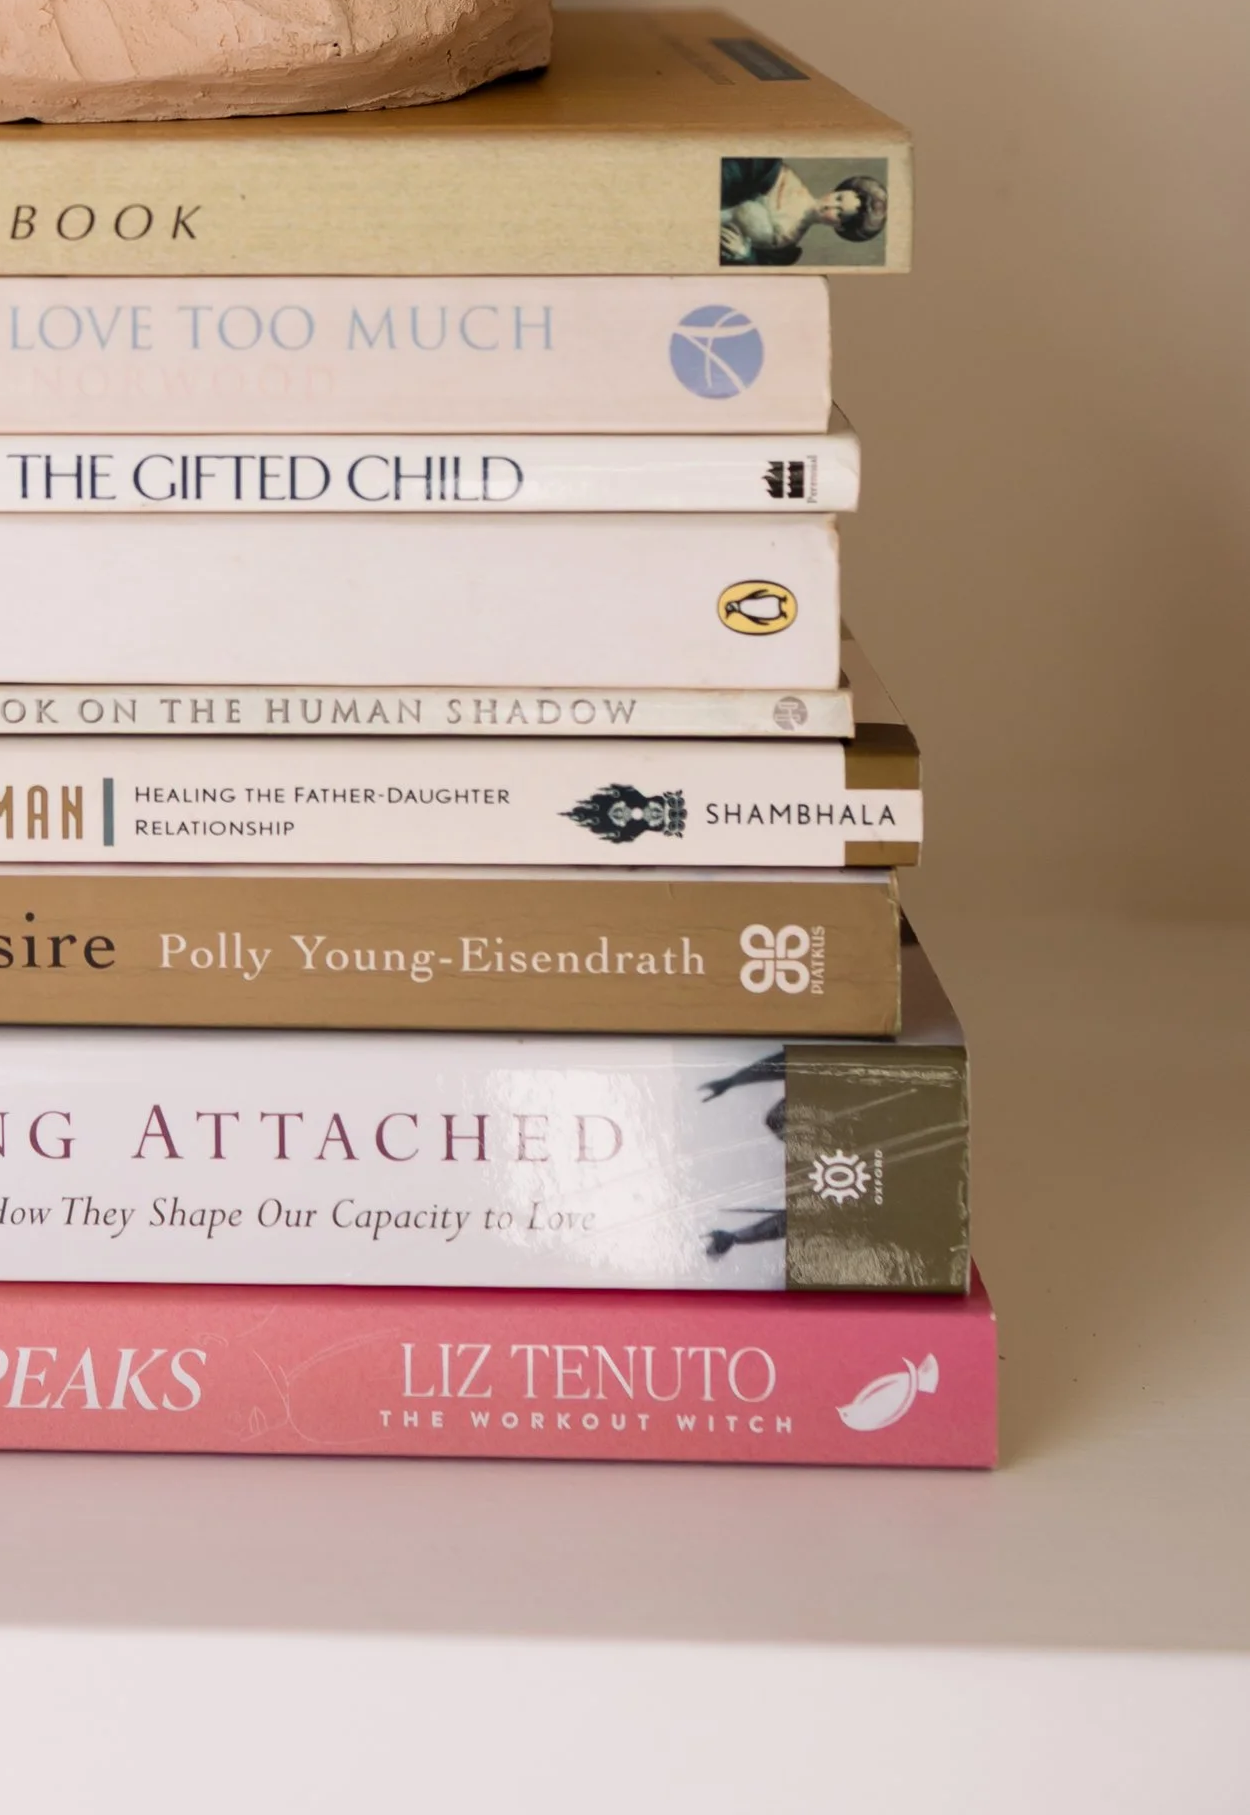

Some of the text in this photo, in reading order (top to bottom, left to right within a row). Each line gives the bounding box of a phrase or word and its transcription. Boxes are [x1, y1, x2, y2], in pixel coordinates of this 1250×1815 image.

[10, 204, 201, 241] BOOK
[11, 303, 153, 351] LOVE
[177, 304, 315, 351] TOO
[348, 304, 554, 351] MUCH
[7, 454, 116, 500] THE
[132, 454, 331, 501] GIFTED
[347, 455, 524, 502] CHILD
[78, 698, 137, 724] ON
[159, 698, 241, 724] THE
[265, 698, 422, 725] HUMAN
[446, 698, 637, 725] SHADOW
[135, 786, 510, 805] HEALING THE FATHER-DAUGHTER
[706, 802, 896, 826] SHAMBHALA
[135, 819, 295, 836] RELATIONSHIP
[159, 931, 705, 983] Polly Young-Eisendrath
[810, 925, 826, 995] PIATKUS
[131, 1104, 625, 1162] ATTACHED
[873, 1148, 884, 1206] OXFORD
[61, 1195, 136, 1239] They
[149, 1196, 243, 1240] Shape
[257, 1198, 318, 1228] Our
[331, 1199, 471, 1243] Capacity
[483, 1208, 513, 1230] to
[524, 1199, 595, 1234] Love
[401, 1342, 776, 1402] LIZ TENUTO
[379, 1409, 792, 1434] THE WORKOUT WITCH
